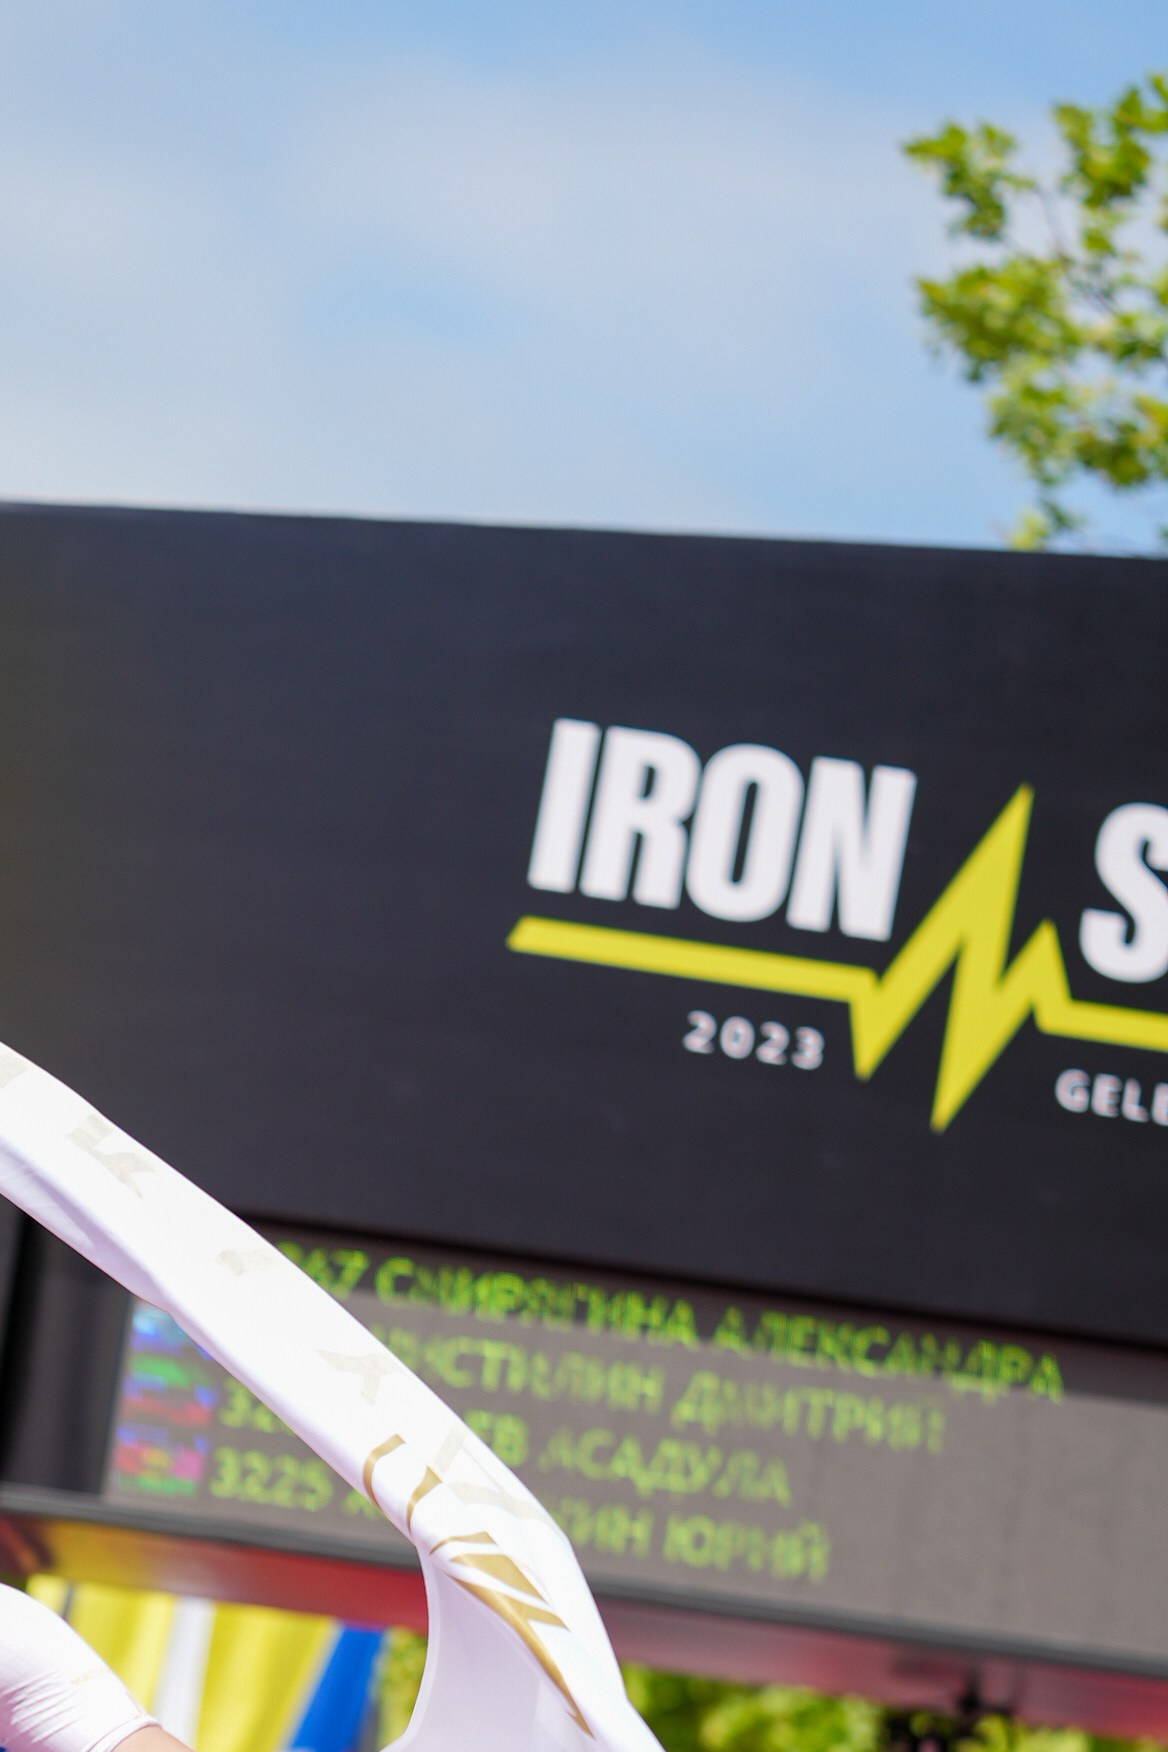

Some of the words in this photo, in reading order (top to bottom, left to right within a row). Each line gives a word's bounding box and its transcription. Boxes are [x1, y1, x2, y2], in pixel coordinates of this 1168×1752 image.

[528, 718, 917, 942] IRON
[683, 1010, 825, 1070] 2023
[712, 1305, 1065, 1406] АЛЕКСАНДРА
